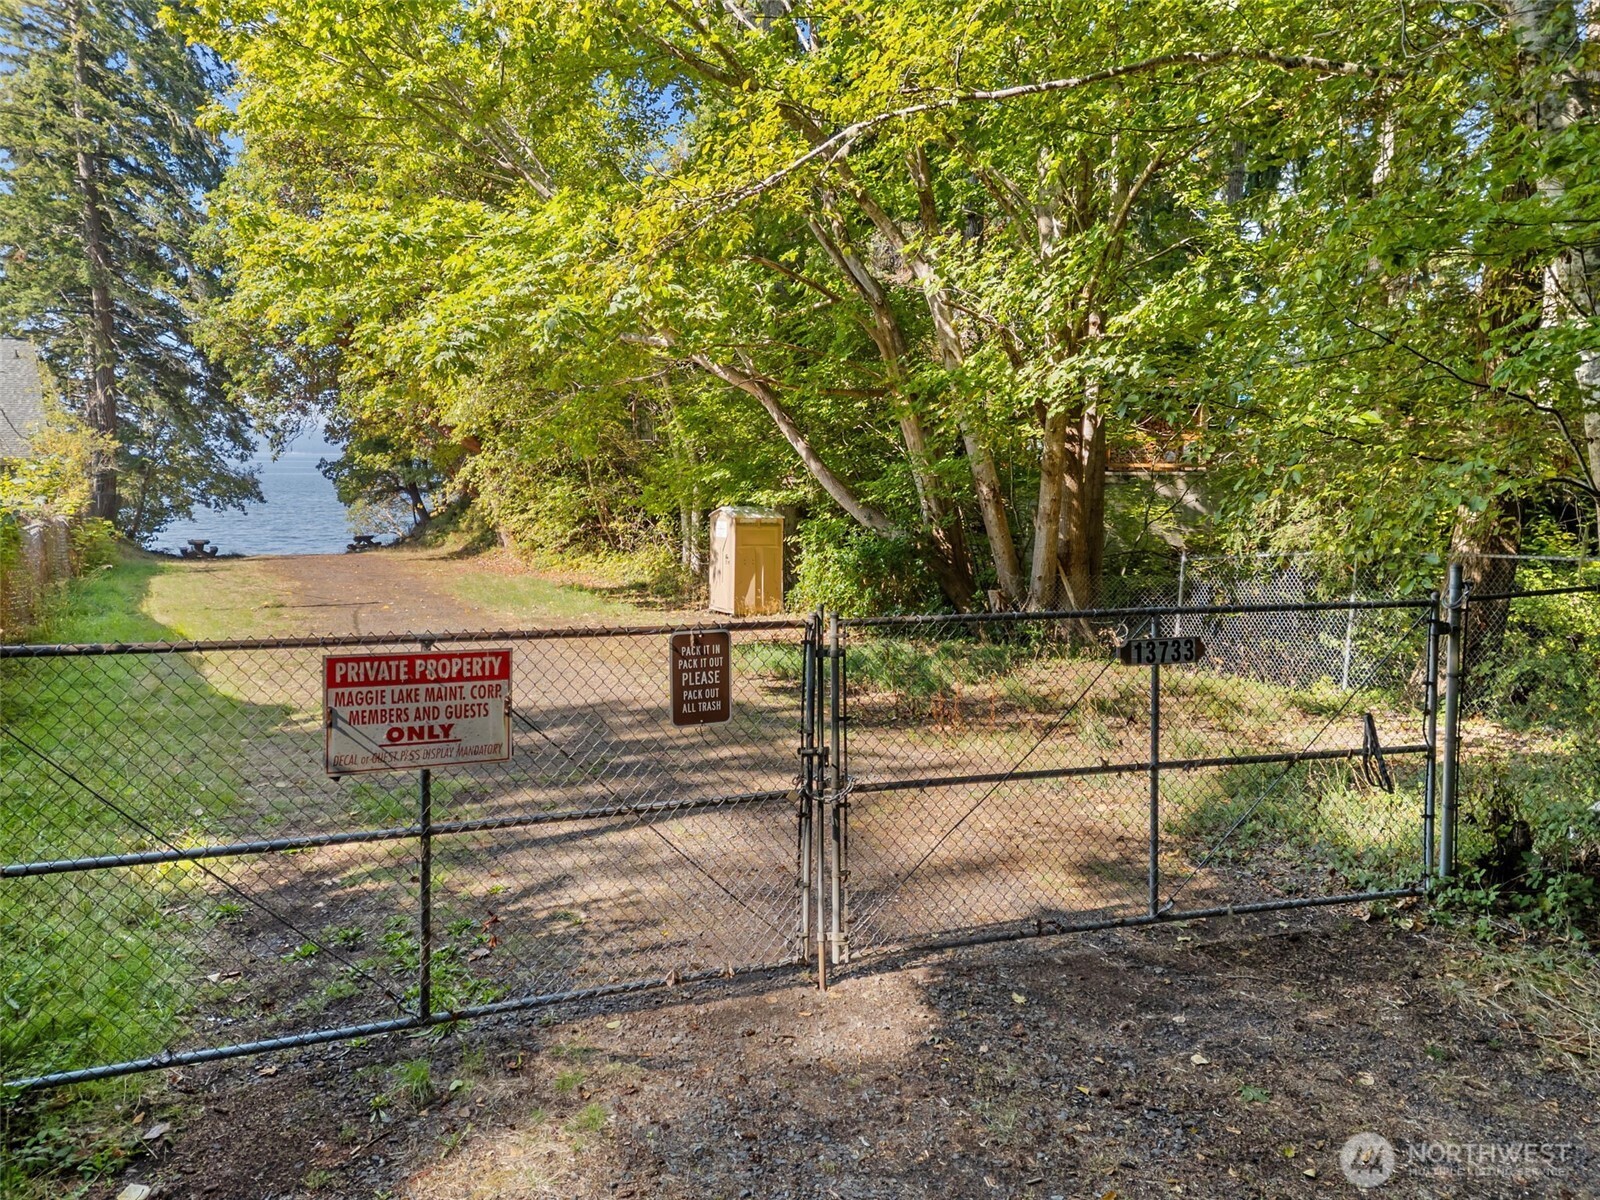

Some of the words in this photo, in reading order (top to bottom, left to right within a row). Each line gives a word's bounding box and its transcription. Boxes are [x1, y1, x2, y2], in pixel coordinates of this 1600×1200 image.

[682, 646, 701, 656] PACK
[704, 645, 709, 655] IT
[713, 644, 720, 654] IN
[1134, 639, 1194, 663] 13733
[335, 660, 409, 683] PRIVATE
[415, 656, 502, 680] PROPERTY
[678, 659, 698, 669] PACK
[701, 658, 707, 668] IT
[710, 657, 723, 667] OUT
[682, 670, 720, 686] PLEASE
[335, 690, 386, 707] MAGGIE
[391, 688, 420, 704] LAKE
[425, 685, 465, 703] MAINT.
[471, 684, 502, 700] CORP.
[683, 690, 702, 700] PACK
[705, 688, 719, 698] OUT
[349, 705, 409, 725] MEMBERS
[414, 706, 440, 722] AND
[445, 703, 489, 720] GUESTS
[682, 704, 696, 713] ALL
[698, 701, 721, 712] TRASH
[386, 724, 455, 743] ONLY
[333, 755, 357, 766] DECAL
[361, 756, 370, 765] or
[423, 747, 454, 760] DISPLAY
[456, 743, 503, 757] MANDATORY
